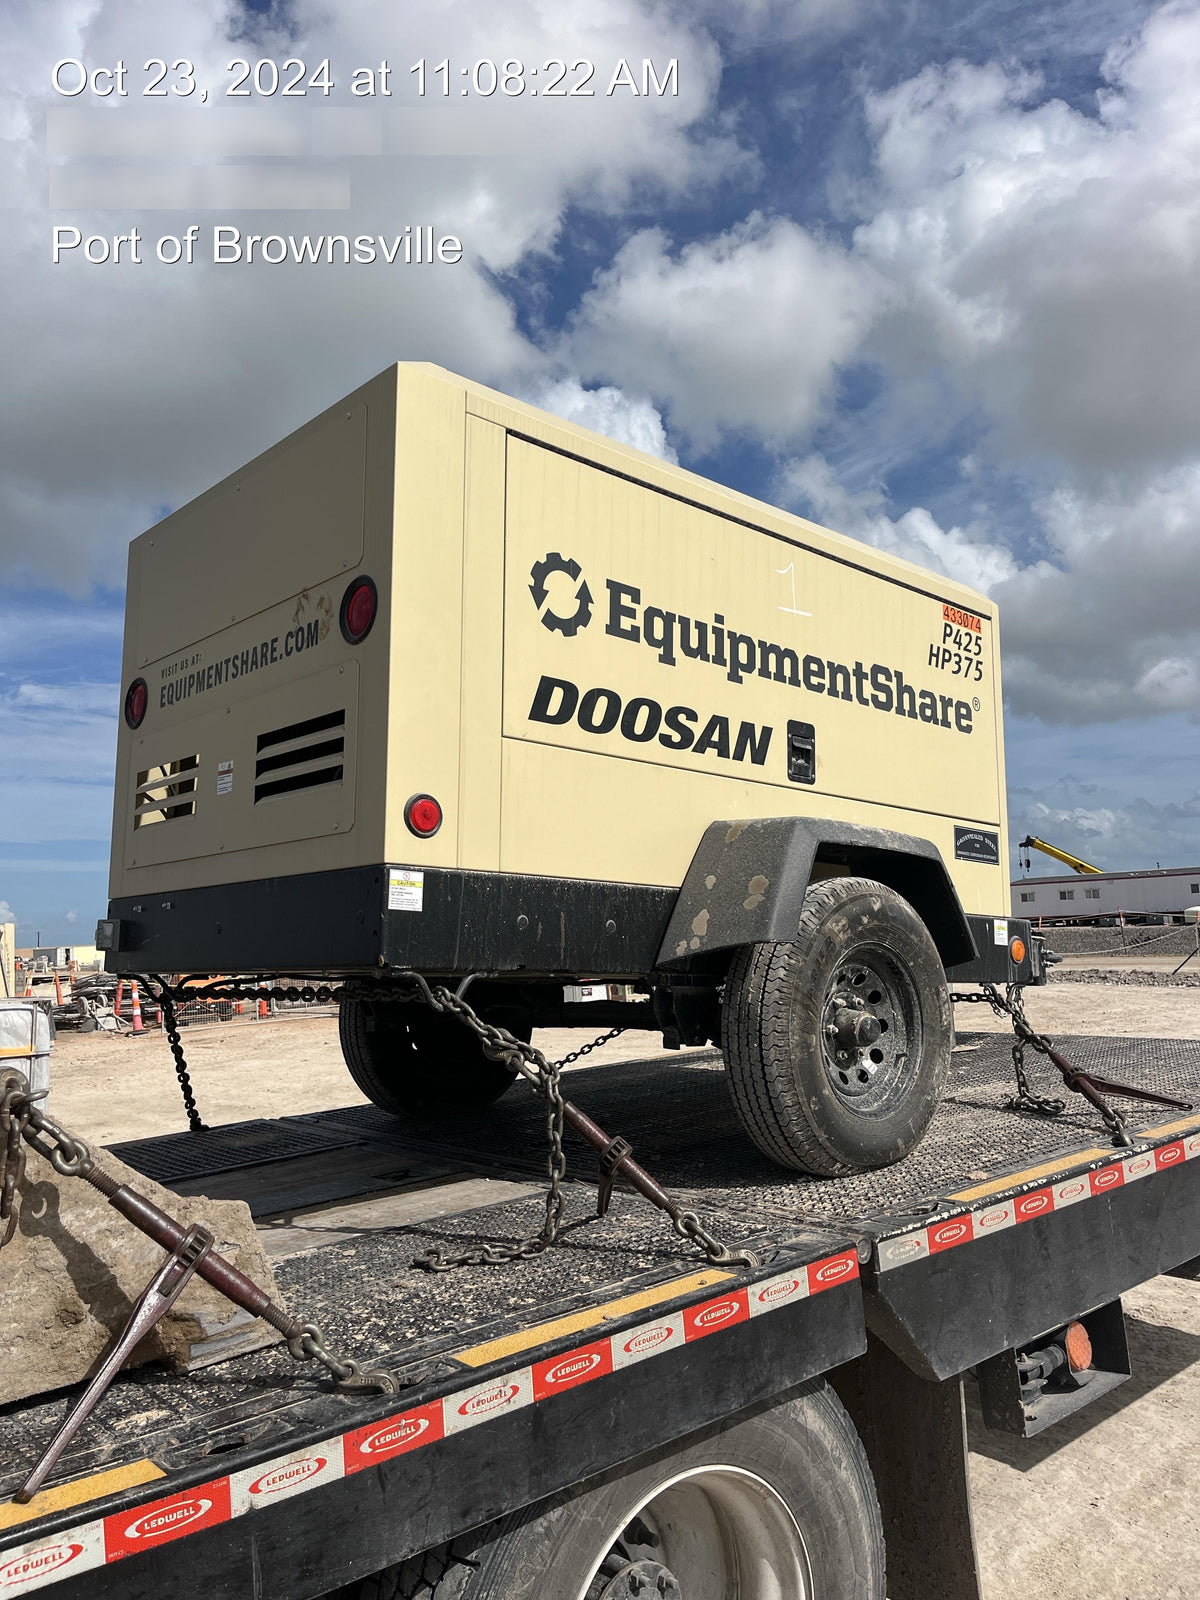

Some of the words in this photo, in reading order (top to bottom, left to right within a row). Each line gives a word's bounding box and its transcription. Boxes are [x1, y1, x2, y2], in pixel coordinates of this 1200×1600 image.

[775, 562, 813, 616] 1
[943, 605, 982, 633] 433074
[942, 622, 982, 656] P425
[159, 619, 319, 709] EQUIPMENTSHARE.COM
[161, 663, 178, 679] VISIT
[180, 658, 189, 671] US
[928, 643, 983, 682] HP375
[528, 675, 773, 766] DOOSAN
[824, 1262, 847, 1277] LEDWELL
[703, 1304, 732, 1322] LEDWELL
[634, 1330, 665, 1349] LEDWELL
[557, 1359, 591, 1378] LEDWELL
[471, 1390, 509, 1410] LEDWELL
[375, 1425, 416, 1446] LEDWELL
[266, 1464, 312, 1487] LEDWELL
[143, 1506, 196, 1531] LEDWELL
[7, 1552, 64, 1578] LEDWELL
